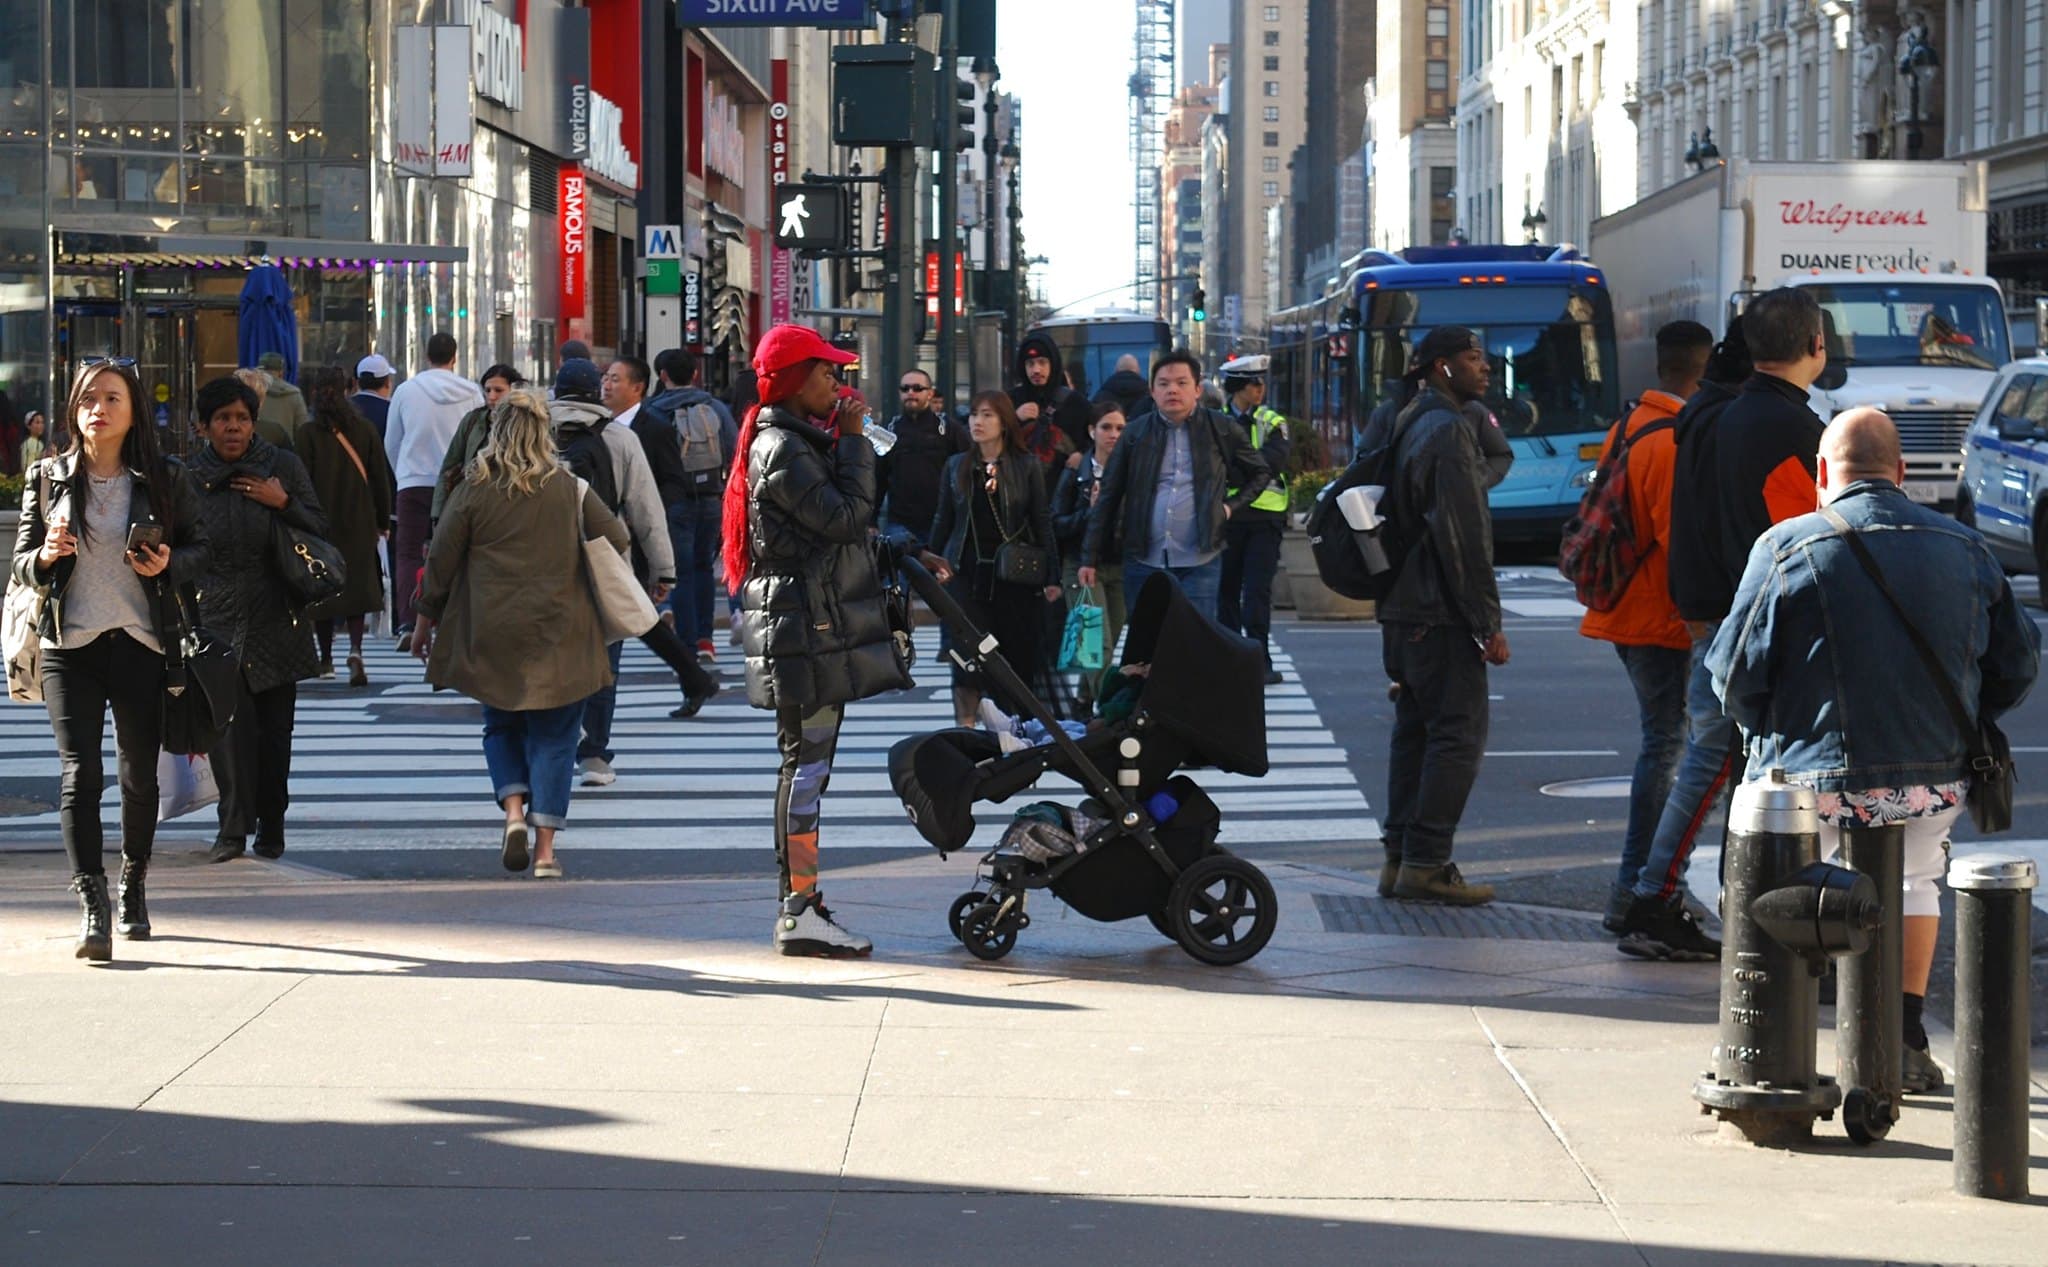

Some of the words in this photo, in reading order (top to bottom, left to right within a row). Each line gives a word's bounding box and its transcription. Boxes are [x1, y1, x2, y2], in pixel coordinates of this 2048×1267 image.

[706, 0, 776, 13] Sixth
[785, 0, 840, 12] Ave
[569, 84, 586, 154] verizon
[565, 177, 583, 254] FAMOUS
[1778, 199, 1928, 234] Walgreens
